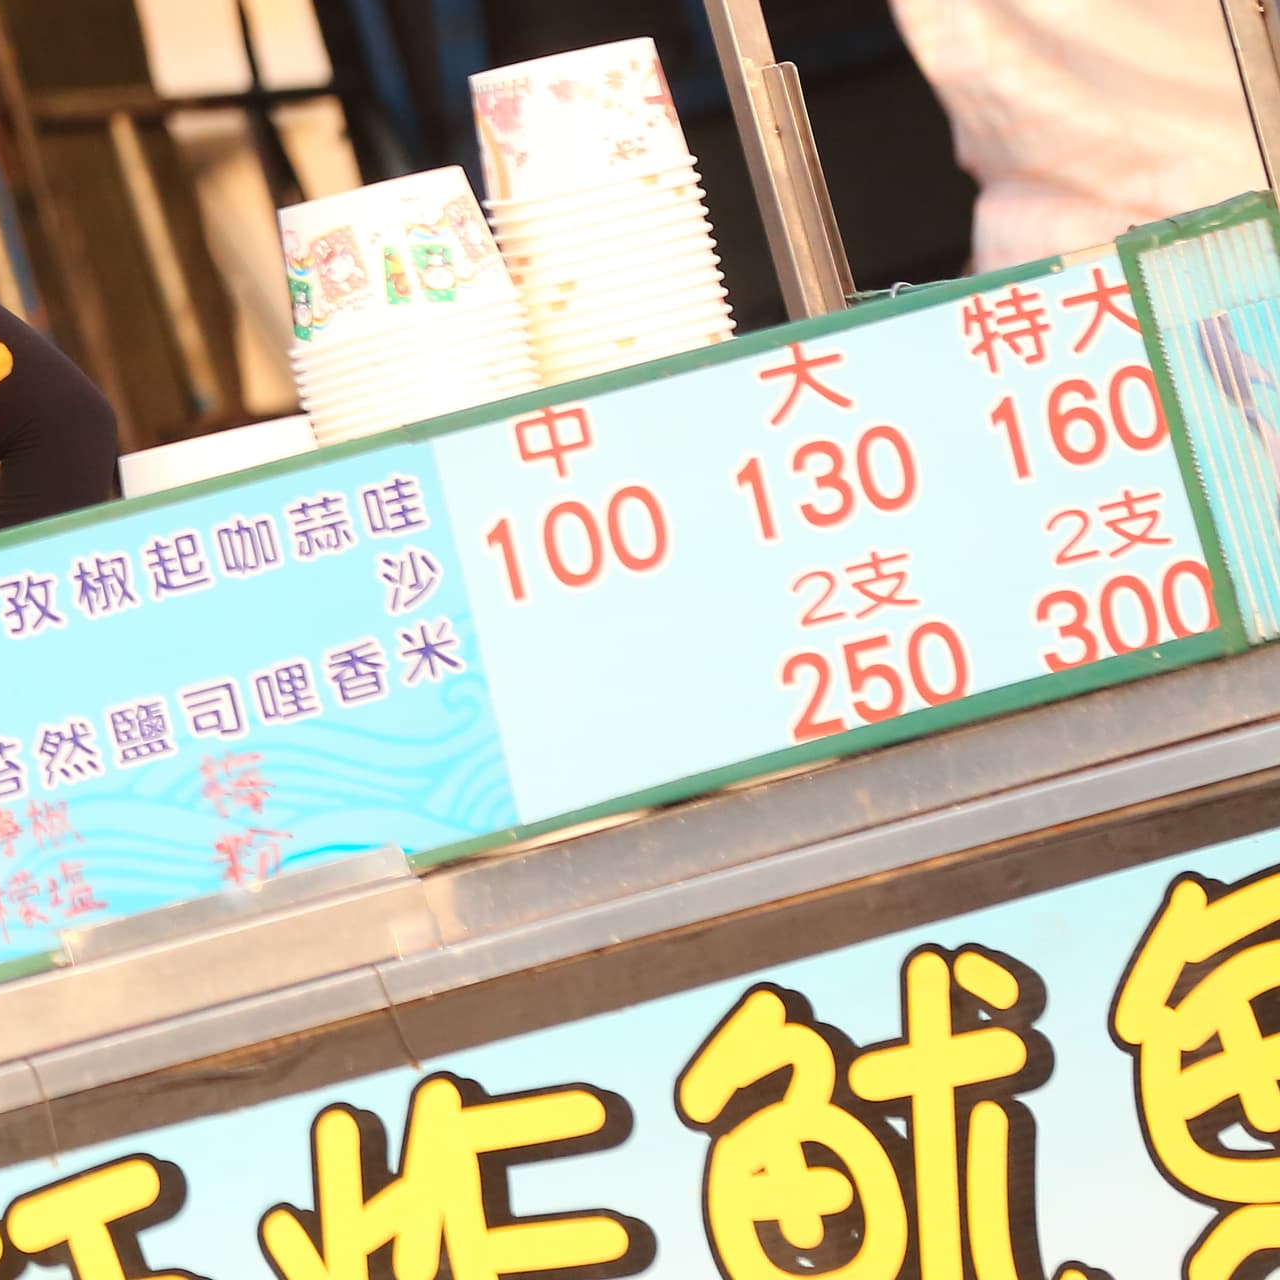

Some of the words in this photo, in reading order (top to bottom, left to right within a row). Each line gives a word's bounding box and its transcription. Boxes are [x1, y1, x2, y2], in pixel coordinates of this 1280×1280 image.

[961, 266, 1144, 374] 特大
[758, 341, 854, 428] 大
[987, 362, 1174, 481] 160
[513, 405, 593, 480] 中
[734, 424, 919, 542] 130
[484, 483, 670, 603] 100
[1044, 489, 1174, 567] 2支
[790, 551, 920, 629] 2支
[1034, 558, 1221, 676] 300
[780, 619, 970, 745] 250
